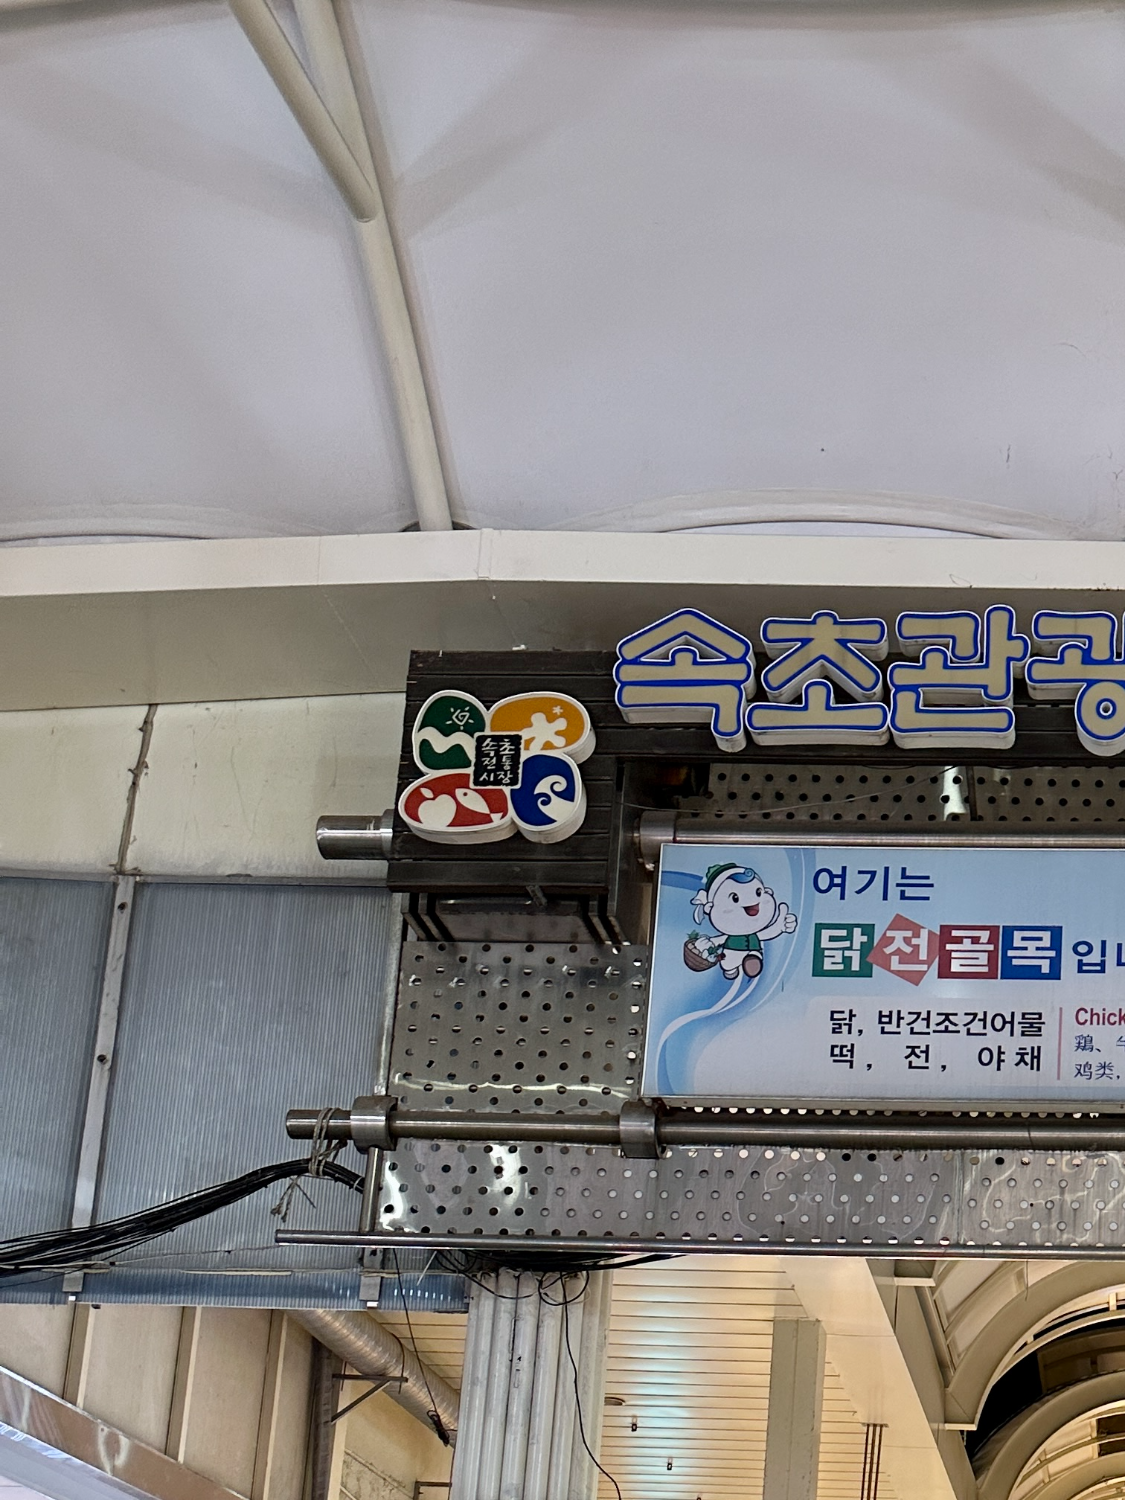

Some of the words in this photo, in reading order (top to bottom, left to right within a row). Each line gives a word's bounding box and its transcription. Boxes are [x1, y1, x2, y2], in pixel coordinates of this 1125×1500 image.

[813, 866, 934, 901] 여기는
[829, 1008, 864, 1037] 닭,
[877, 1009, 1046, 1038] 반건조건어물
